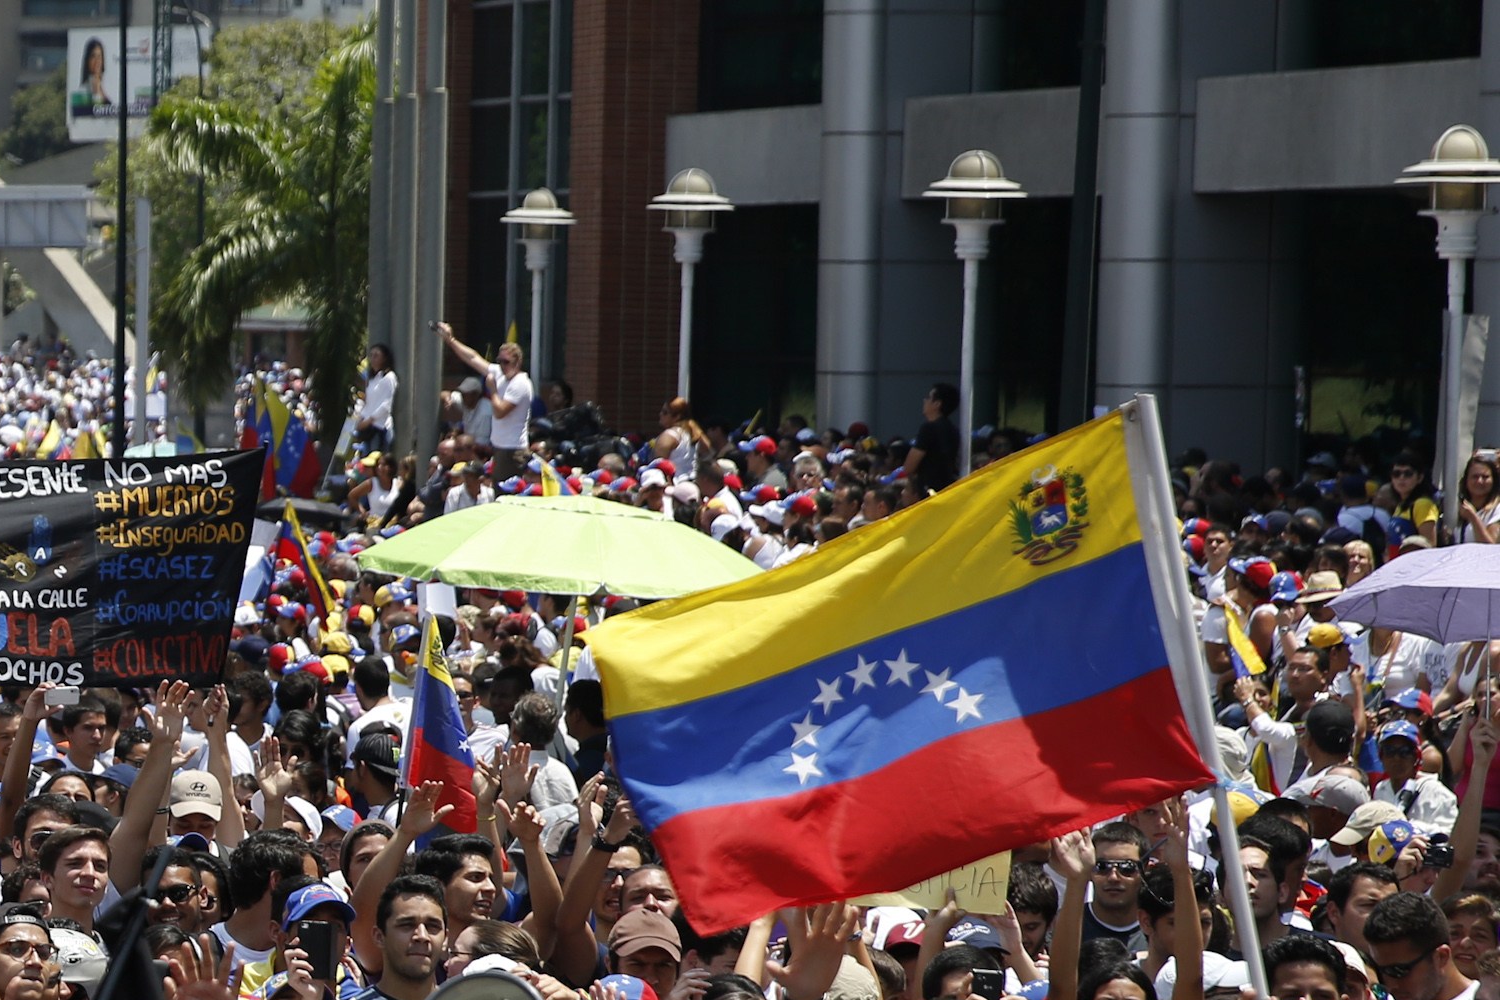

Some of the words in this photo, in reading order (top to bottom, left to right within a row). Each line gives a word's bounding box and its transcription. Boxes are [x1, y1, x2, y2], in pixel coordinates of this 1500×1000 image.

[104, 460, 152, 488] NO
[164, 459, 227, 488] MAS
[94, 485, 235, 517] #MUERTOS
[99, 554, 214, 581] #ESCASEZ
[38, 588, 87, 608] CALLE
